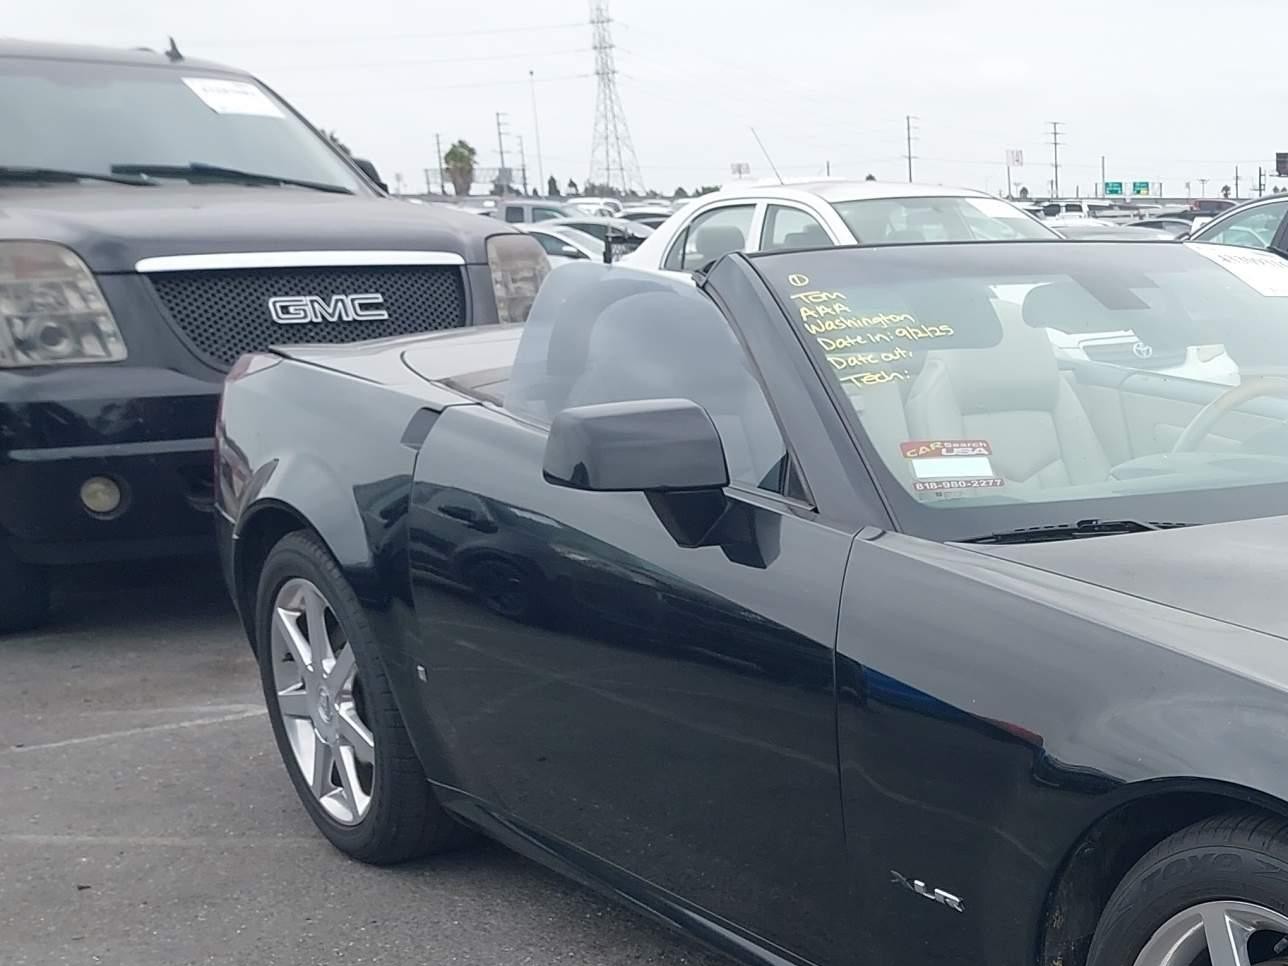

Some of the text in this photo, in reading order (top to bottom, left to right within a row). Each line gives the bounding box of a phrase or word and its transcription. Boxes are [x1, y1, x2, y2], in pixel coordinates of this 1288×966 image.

[268, 293, 389, 324] GMC
[799, 302, 852, 321] AAA
[804, 313, 915, 335] Washington
[817, 334, 867, 351] Date
[827, 354, 879, 370] Date
[906, 441, 945, 457] CAR
[941, 447, 989, 456] USA
